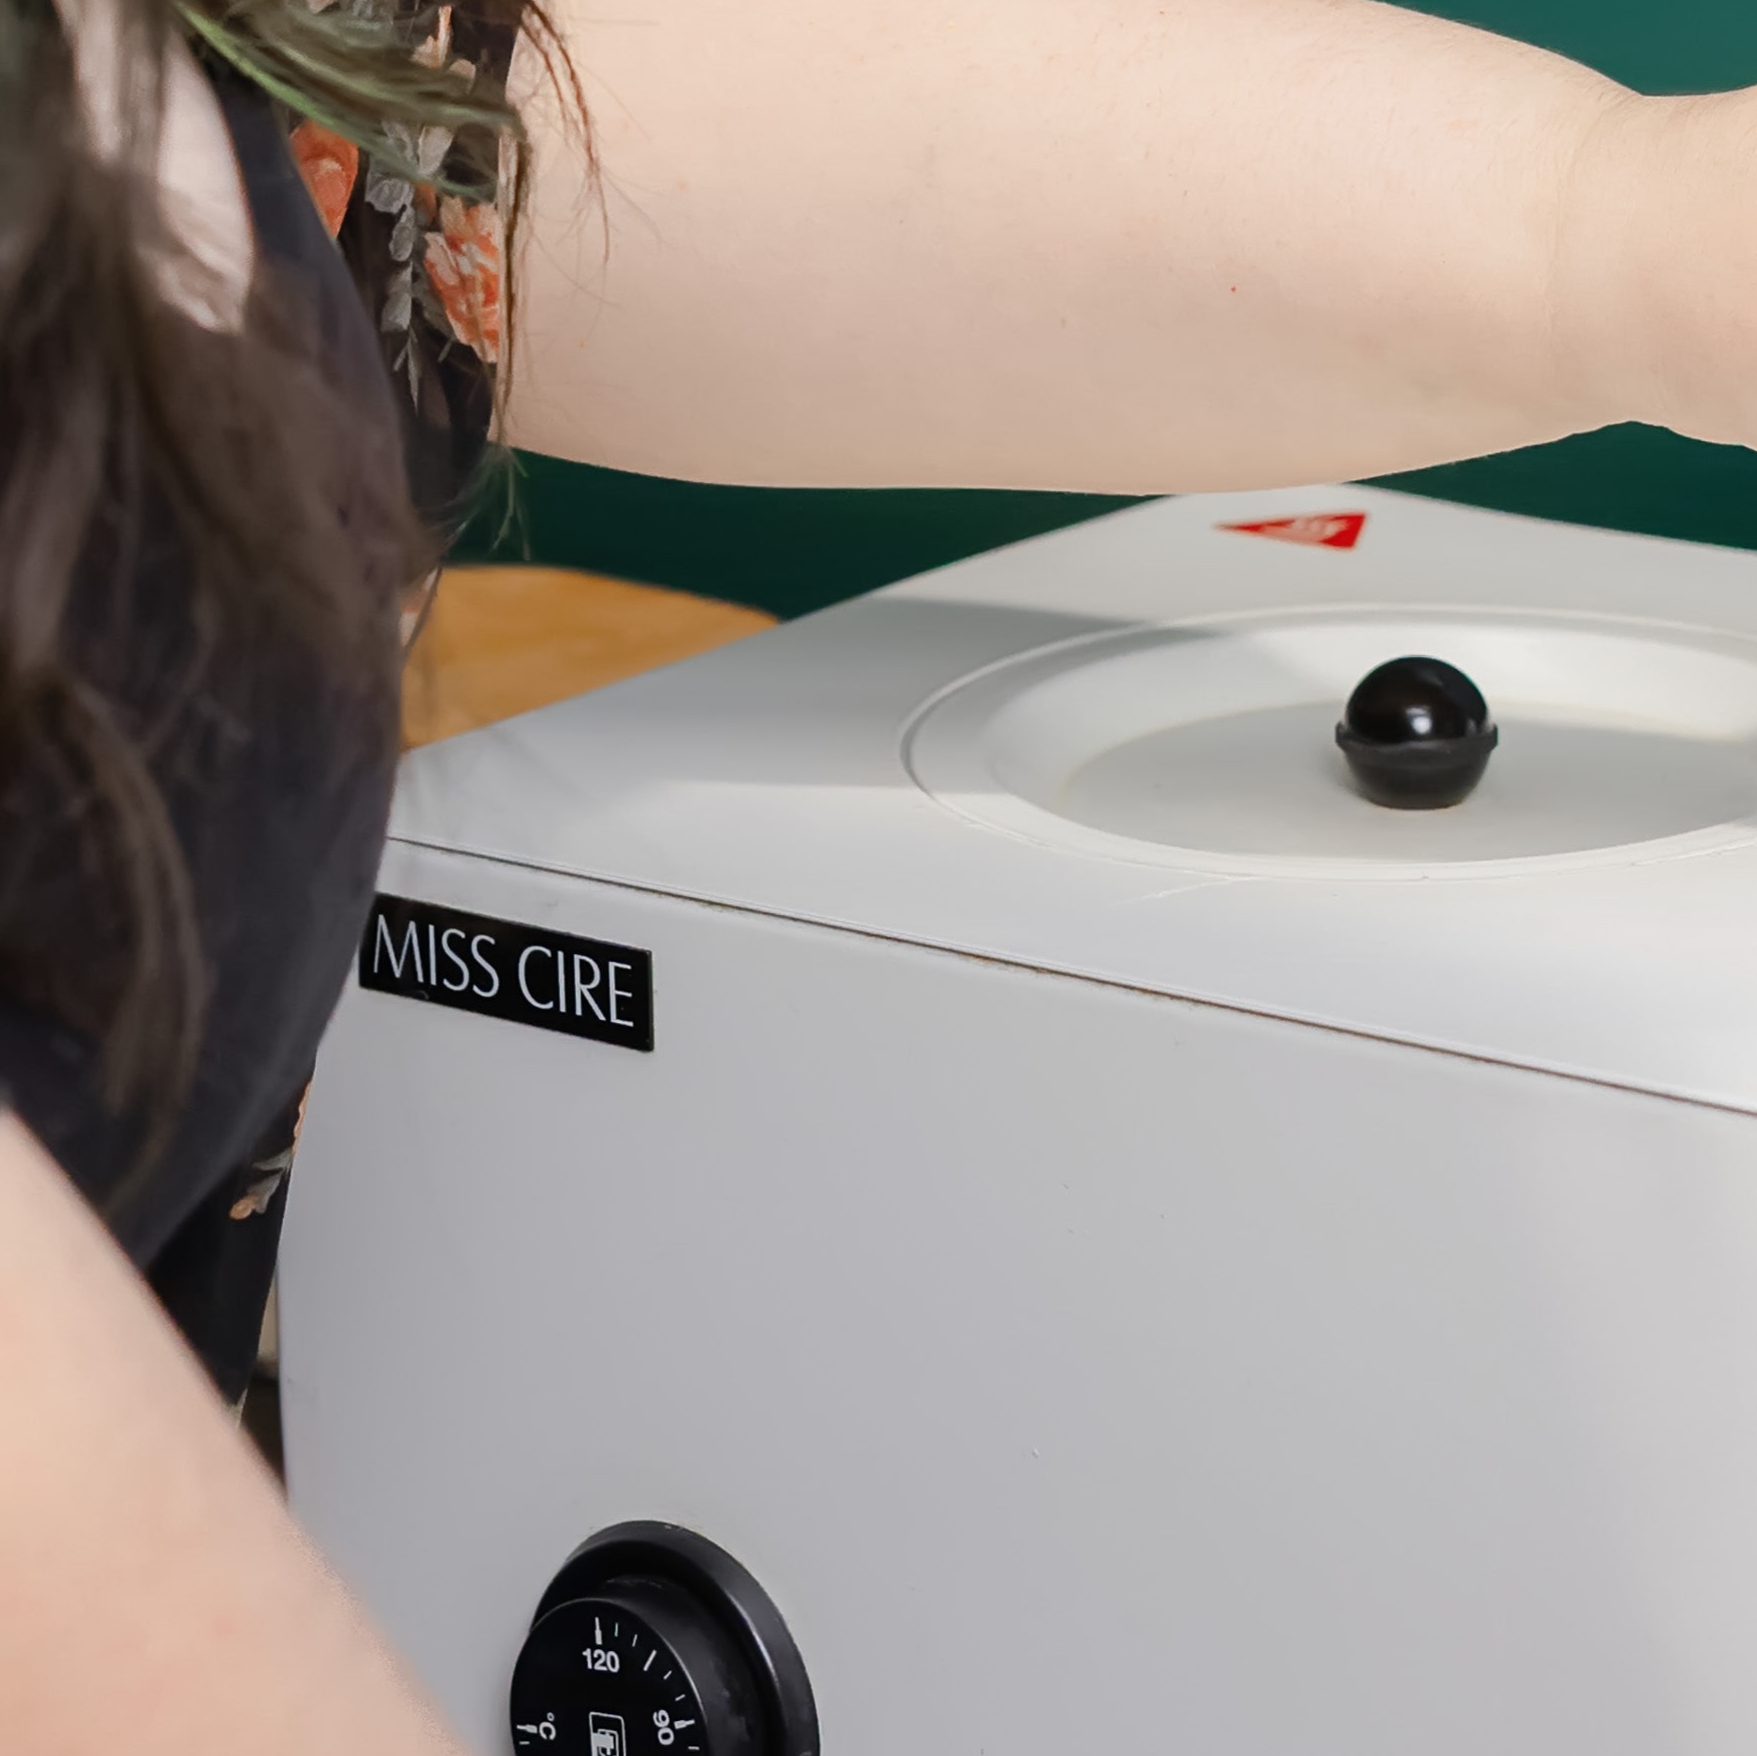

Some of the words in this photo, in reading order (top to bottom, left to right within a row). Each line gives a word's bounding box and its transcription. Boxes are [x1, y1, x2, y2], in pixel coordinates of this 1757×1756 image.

[373, 913, 501, 999] MISS
[517, 944, 635, 1028] CIRE
[582, 1648, 620, 1673] 120
[652, 1709, 675, 1746] 90
